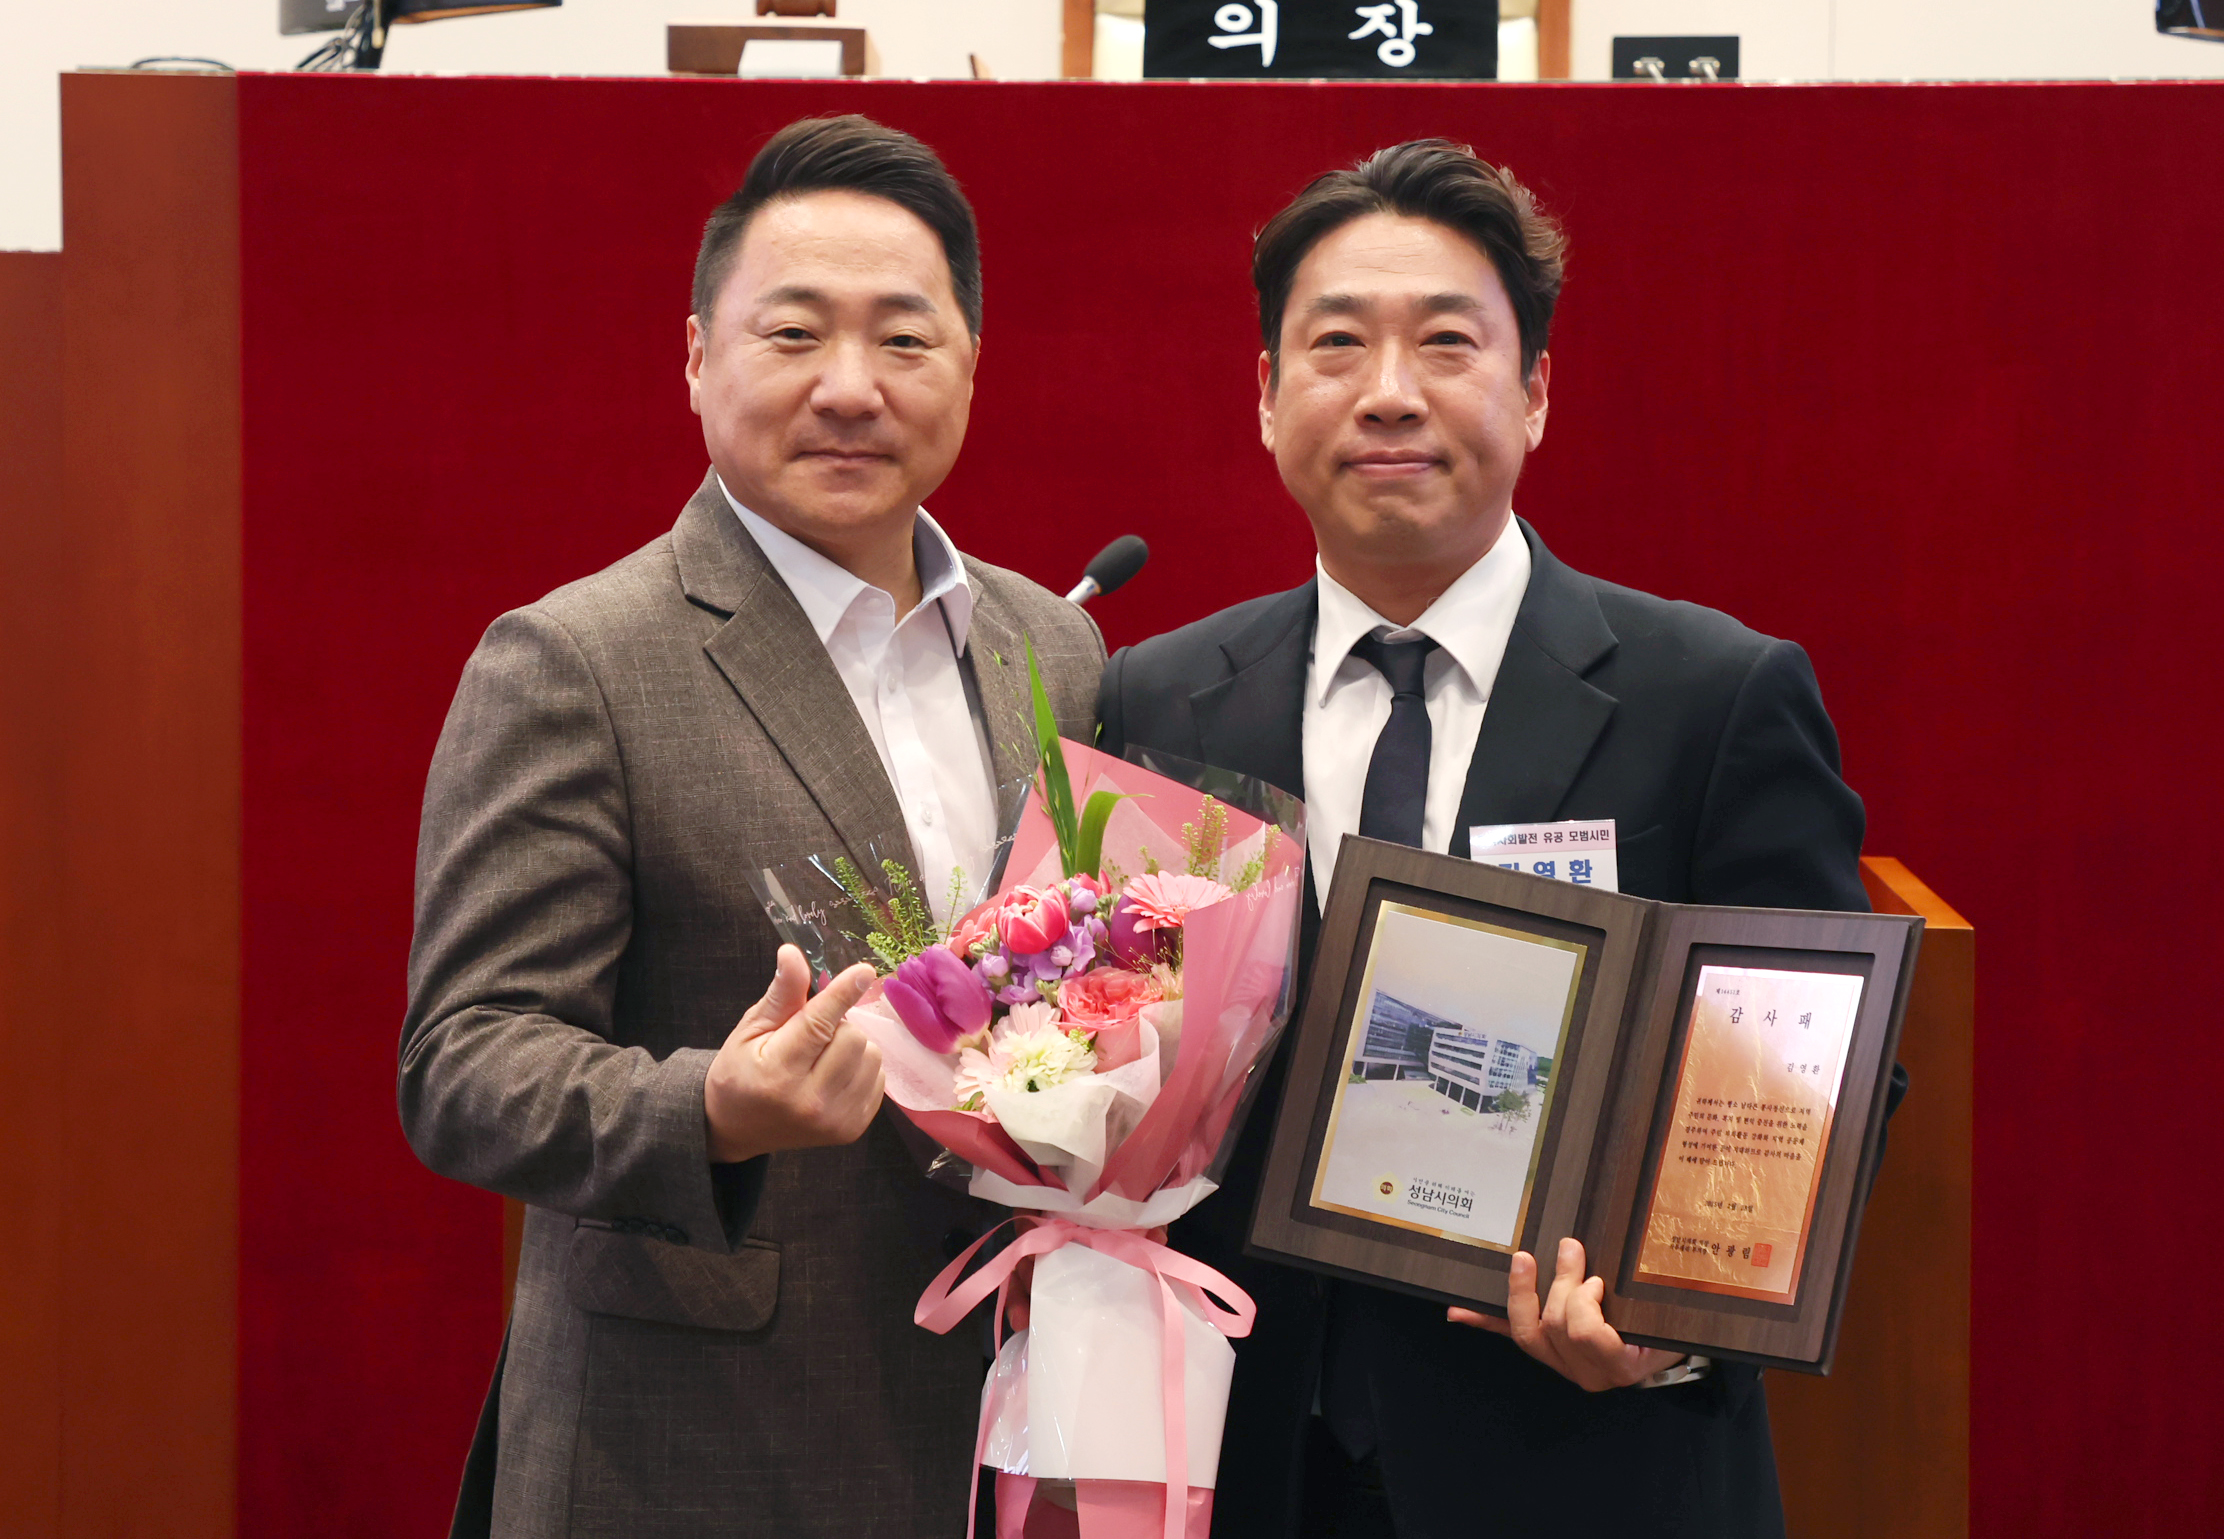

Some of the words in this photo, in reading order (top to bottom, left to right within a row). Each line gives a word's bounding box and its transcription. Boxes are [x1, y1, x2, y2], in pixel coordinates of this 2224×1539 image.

[1207, 0, 1278, 67] 의
[1348, 0, 1433, 67] 장
[1494, 833, 1537, 846] 사회발전
[1544, 832, 1563, 843] 유공
[1569, 830, 1609, 842] 모범시민
[1569, 859, 1592, 884] 환
[1730, 1006, 1744, 1024] 감
[1763, 1009, 1777, 1027] 사
[1798, 1012, 1812, 1029] 패
[1407, 1200, 1436, 1210] Seongnam
[1449, 1210, 1469, 1219] Council
[1409, 1185, 1473, 1212] 성남시의회
